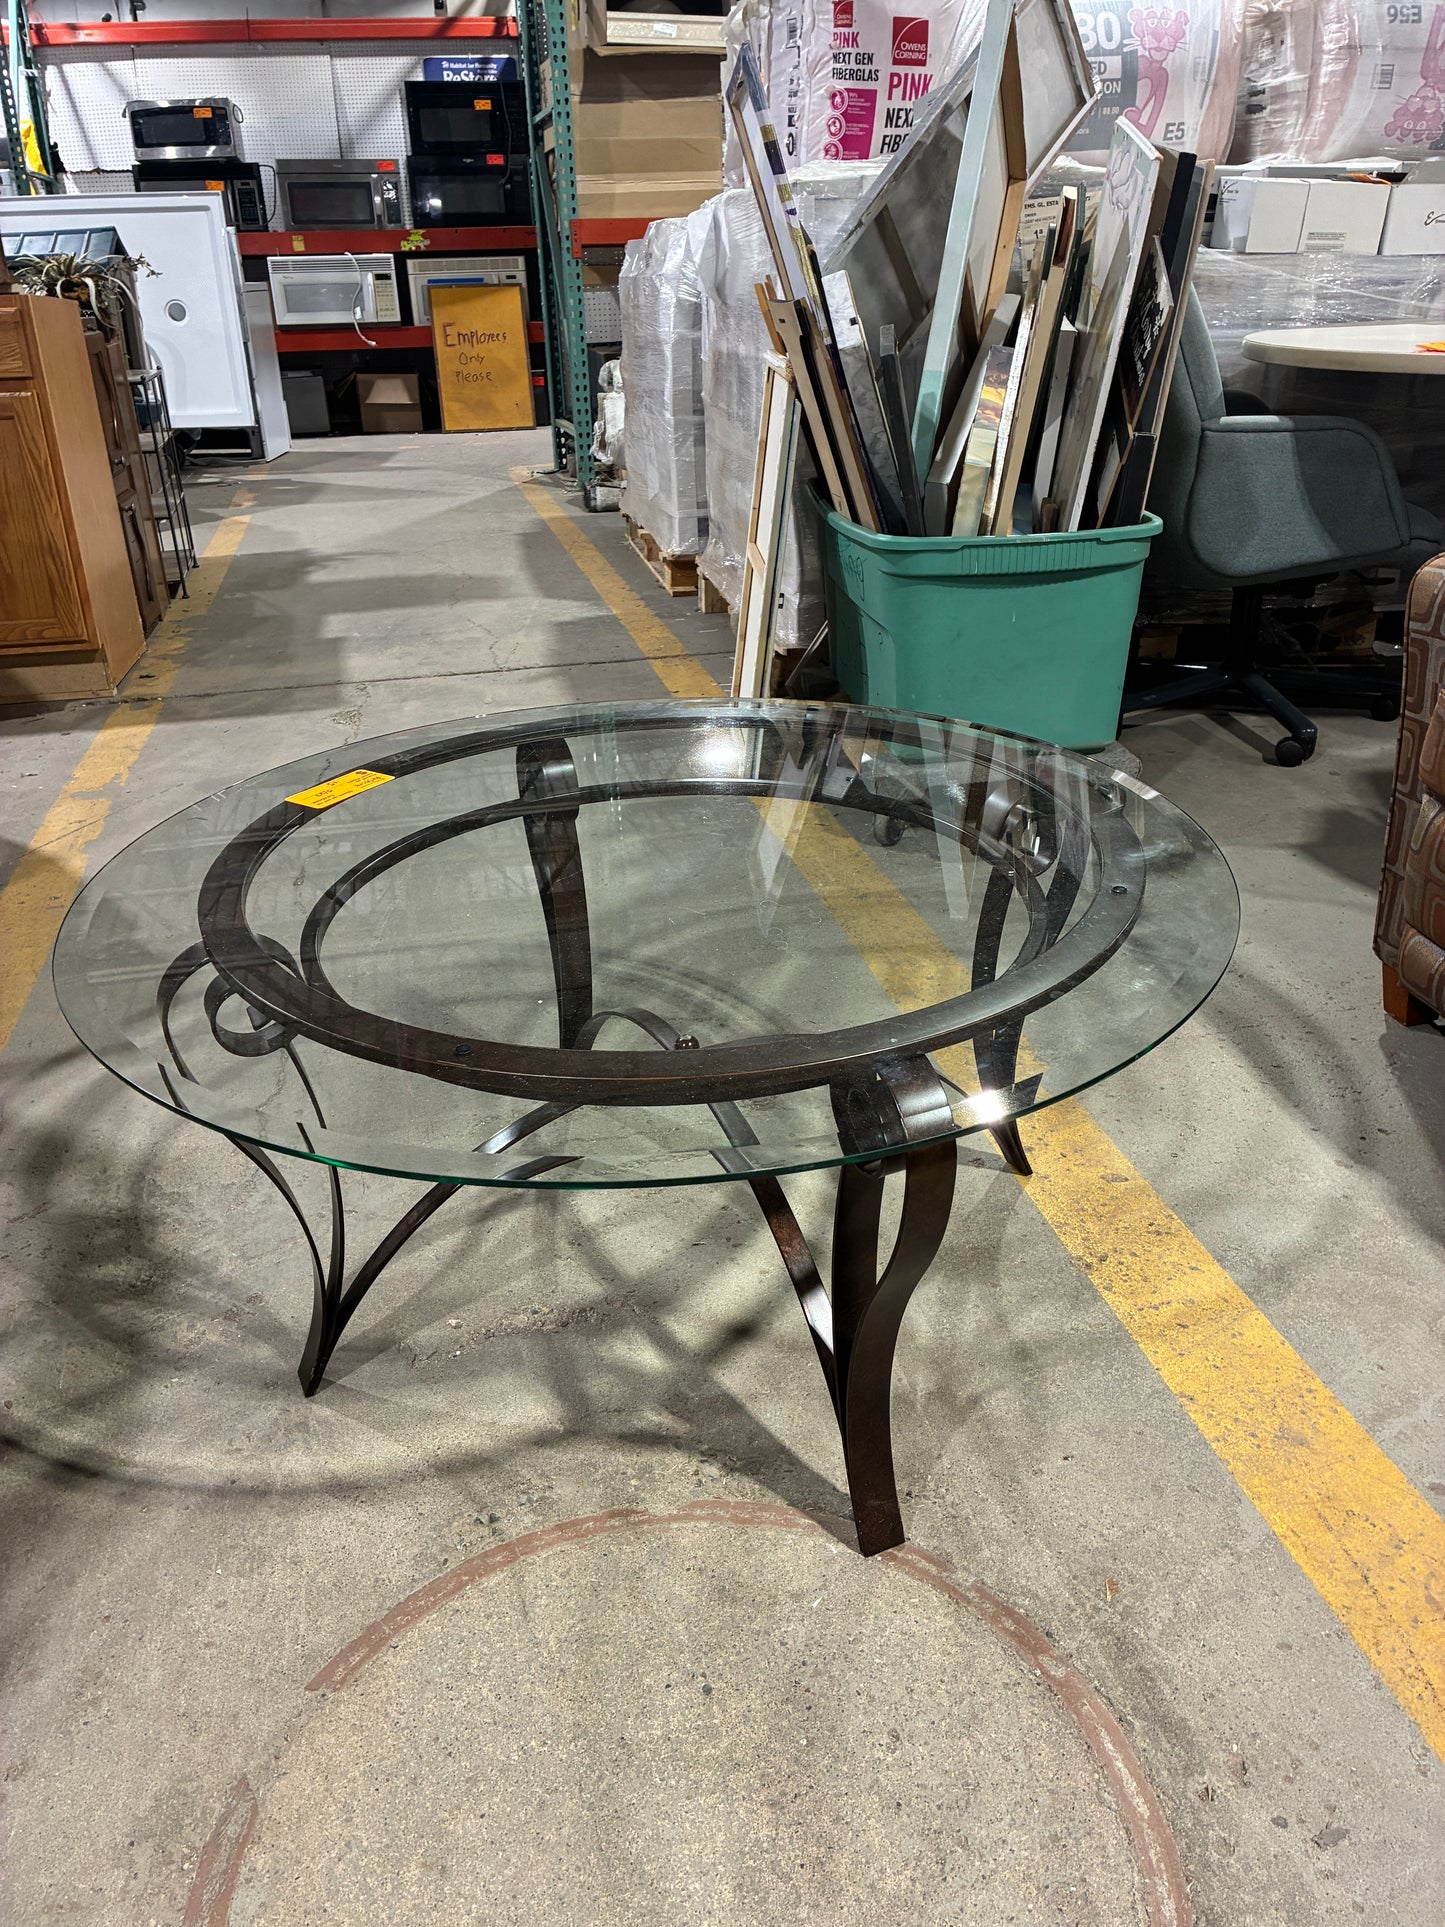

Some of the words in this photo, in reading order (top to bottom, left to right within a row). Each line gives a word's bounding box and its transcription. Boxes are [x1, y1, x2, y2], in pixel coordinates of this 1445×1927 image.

[833, 31, 860, 49] PINK
[901, 41, 926, 51] OWENS
[832, 52, 852, 65] NEXT
[855, 52, 874, 65] GEN
[894, 50, 926, 60] CORNING
[832, 67, 880, 81] FIBERGLAS
[887, 72, 933, 101] PINK
[884, 107, 914, 129] NEX
[442, 322, 507, 349] Employees
[458, 351, 486, 366] Only
[455, 370, 493, 384] Please
